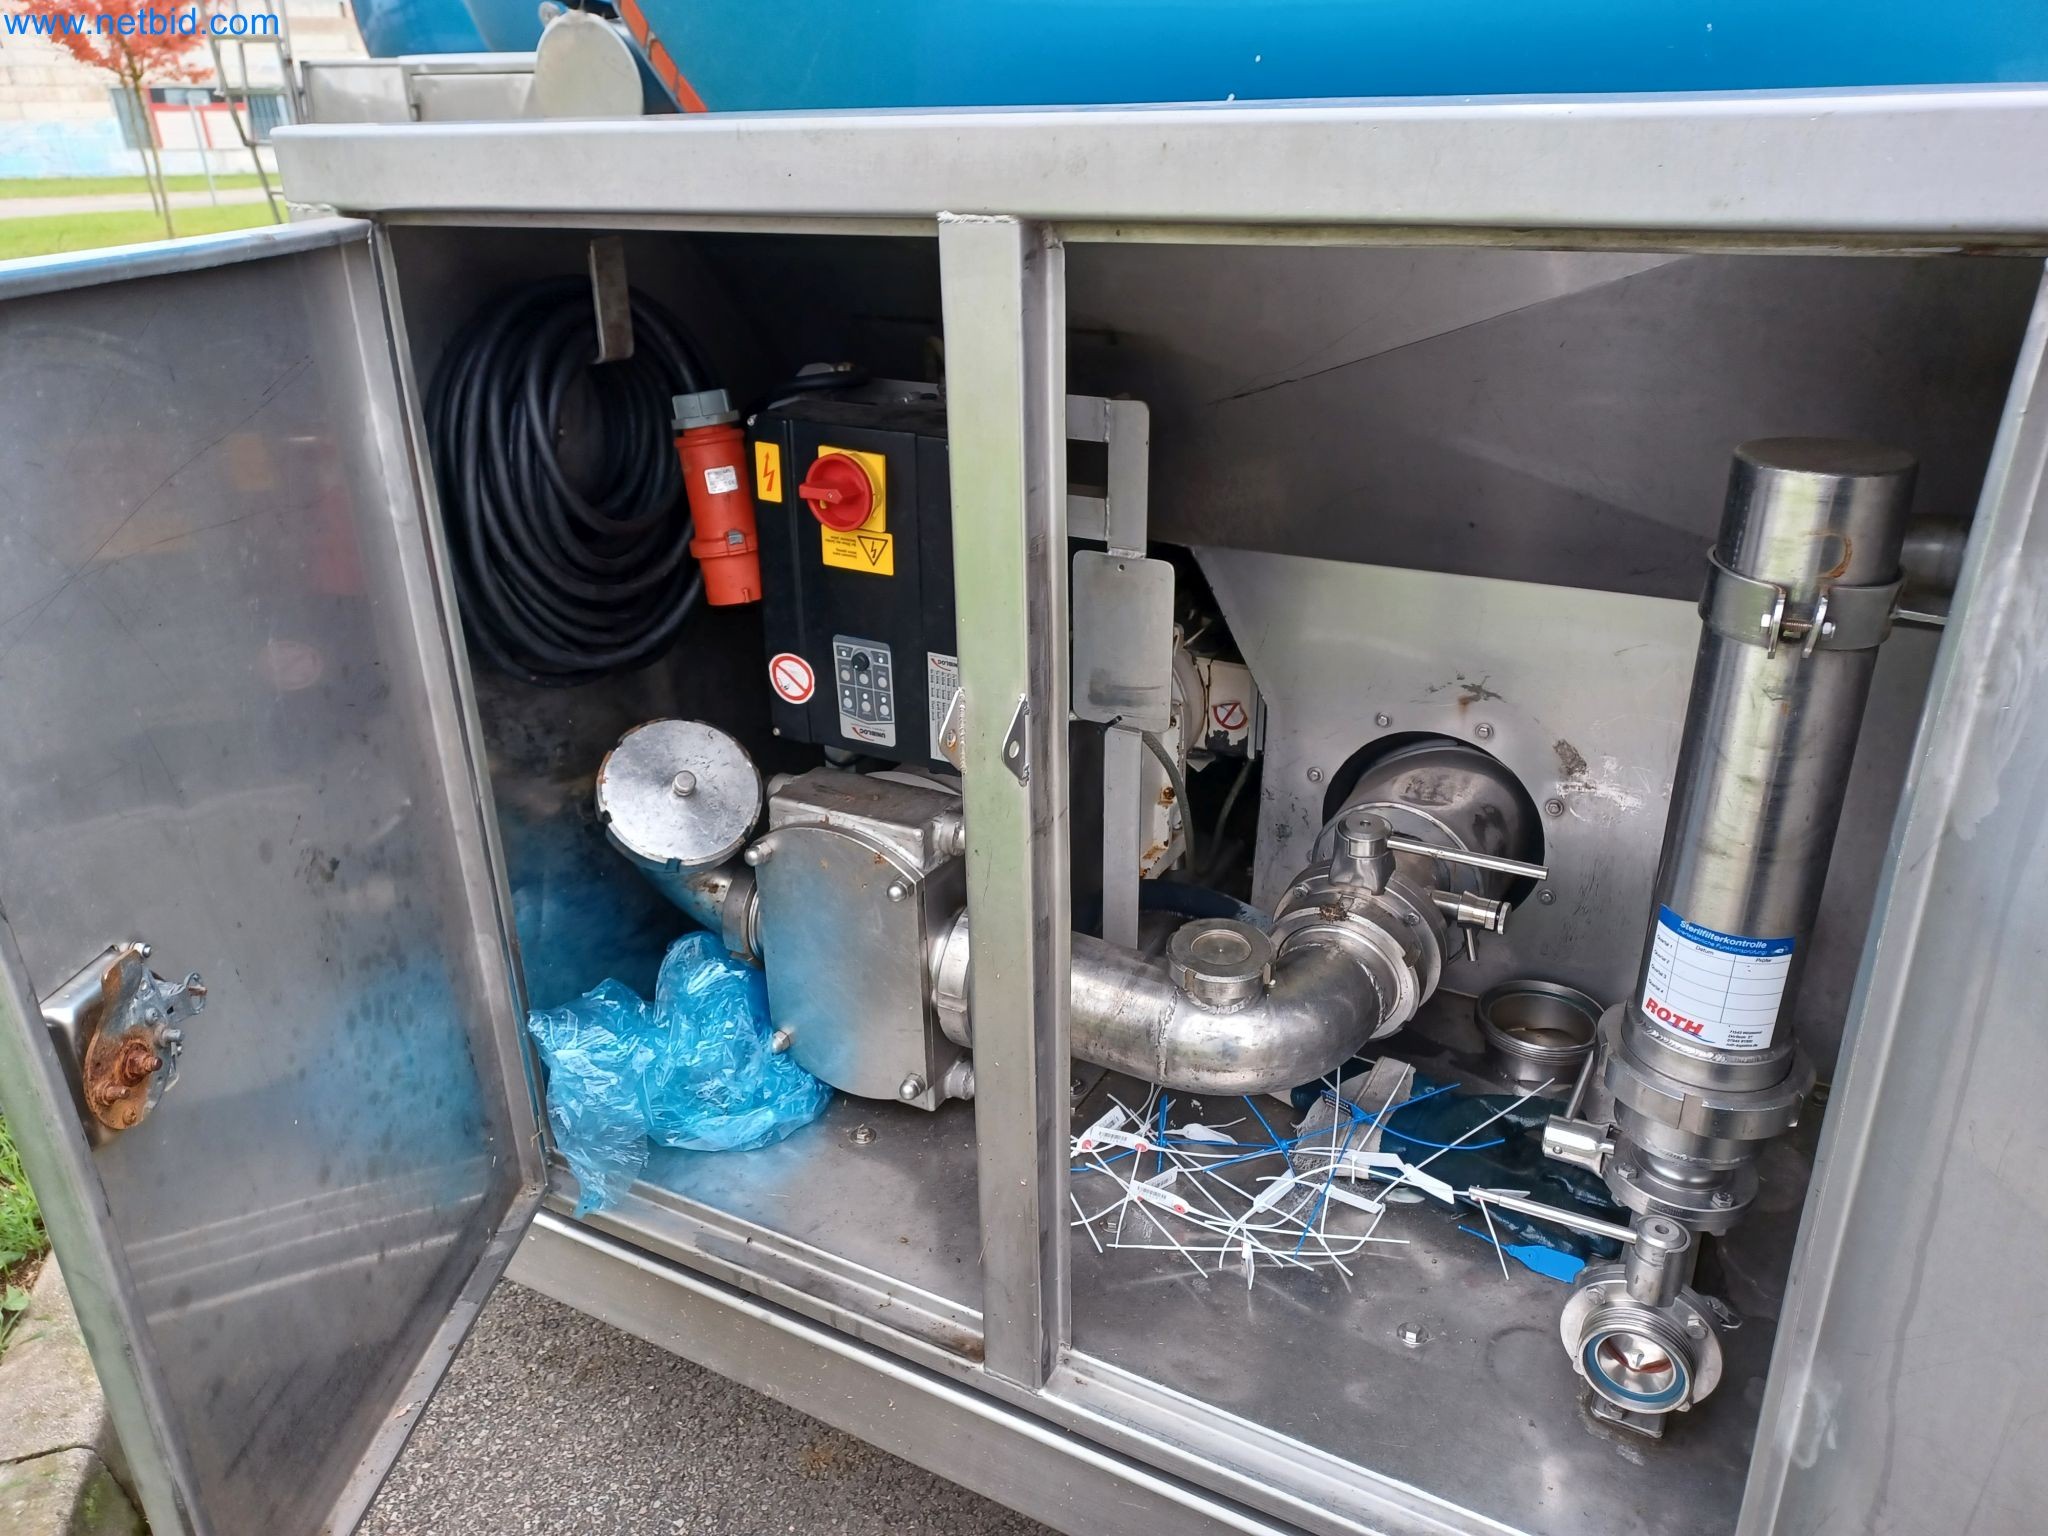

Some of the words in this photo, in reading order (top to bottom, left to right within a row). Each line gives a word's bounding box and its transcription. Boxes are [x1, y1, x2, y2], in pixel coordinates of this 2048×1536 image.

[1680, 920, 1767, 949] Sterilfilterkontrolle
[1695, 945, 1714, 955] Datum
[1645, 997, 1704, 1035] ROTH
